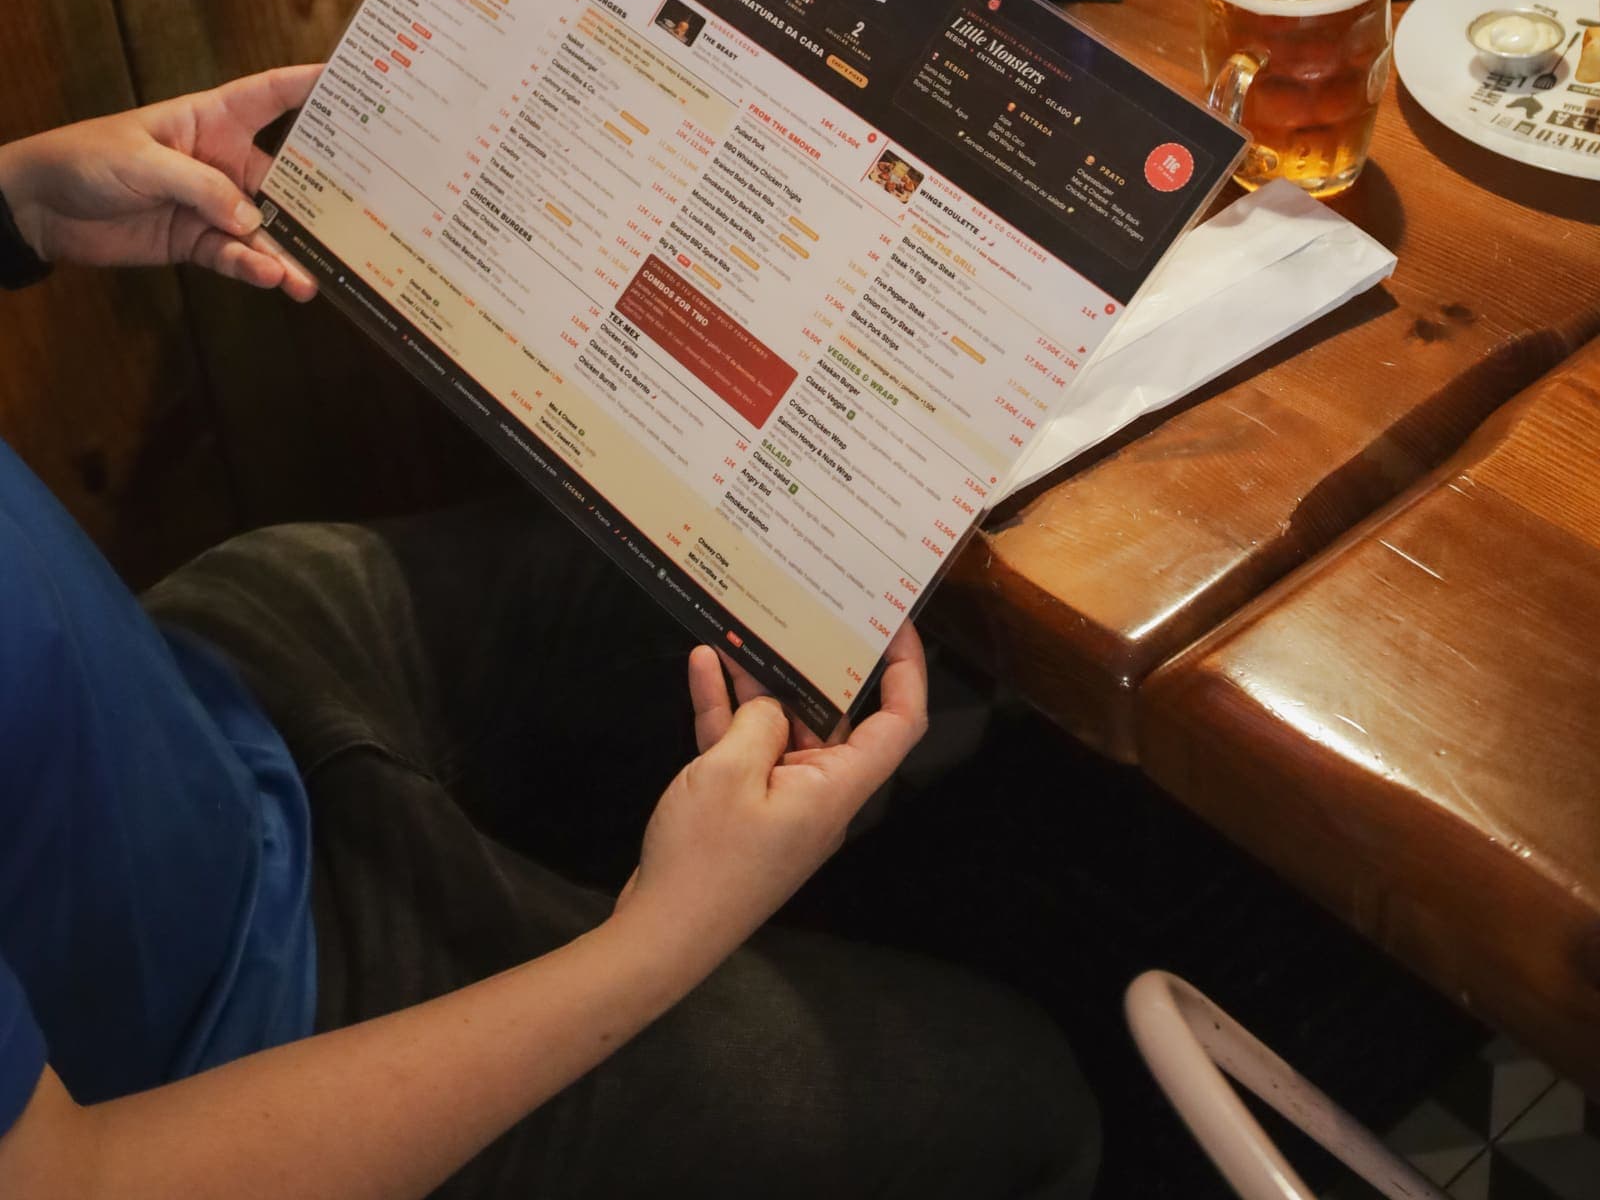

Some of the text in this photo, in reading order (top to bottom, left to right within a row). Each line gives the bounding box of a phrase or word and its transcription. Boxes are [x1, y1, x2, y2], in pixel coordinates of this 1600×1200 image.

[703, 32, 737, 59] THE BEAST
[784, 25, 797, 39] DA
[799, 35, 823, 57] CASA
[851, 21, 864, 37] 2
[561, 42, 597, 72] Cheeseburger
[950, 16, 1045, 84] Little Monsters
[944, 60, 968, 79] BEBIDA
[944, 30, 1071, 118] BEBIDA ENTRADA PRATO GELADO
[734, 124, 765, 151] Pulled Pork
[748, 103, 820, 159] FROM THE SMOKER
[1019, 111, 1052, 136] ENTRADA
[983, 150, 996, 160] com
[998, 137, 1014, 151] Wings
[1017, 150, 1036, 166] Nachos
[303, 173, 323, 192] SIDES
[723, 140, 801, 203] BBQ Whiskey Chicken Thighs
[1076, 168, 1114, 195] Cheeseburger
[1099, 165, 1124, 185] PRATO
[470, 187, 532, 241] CHICKEN BURGERS
[919, 188, 979, 234] WINGS ROULETTE
[1065, 183, 1143, 241] Chicken Tenders Fish Fingers
[1071, 175, 1082, 187] Mac
[1087, 187, 1108, 204] Cheese
[1111, 203, 1125, 216] Baby
[1125, 213, 1139, 225] Back
[928, 175, 961, 201] NOVIDADE
[971, 206, 986, 219] RIBS
[994, 222, 1004, 232] CO
[1005, 231, 1047, 262] CHALLENGE
[901, 236, 955, 279] Blue Cheese Steak
[911, 223, 975, 276] FROM THE GRILL
[890, 253, 907, 269] Steak
[913, 270, 926, 284] Egg
[642, 269, 708, 326] COMBOS FOR TWO
[862, 293, 914, 336] Onion Gravy Steak
[874, 276, 925, 318] Five Pepper Steak
[1081, 306, 1096, 319] 11€
[600, 323, 638, 358] Chicken Fajitas
[609, 311, 639, 340] TEX-MEX
[850, 309, 899, 350] Black Pork Strips
[589, 339, 608, 358] Classic
[607, 354, 620, 368] Ribs
[623, 368, 632, 378] Co
[631, 375, 650, 394] Burrito
[817, 359, 860, 395] Alaskan Burger
[827, 345, 861, 375] VEGGIES
[869, 379, 898, 405] WRAPS
[805, 375, 846, 411] Classic Veggie
[789, 398, 846, 449] Crispy Chicken Wrap
[761, 438, 791, 467] SALADS
[777, 415, 798, 436] Salmon
[798, 432, 817, 452] Honey
[821, 452, 836, 467] Nuts
[836, 464, 852, 481] Wrap
[741, 468, 771, 496] Angry Bird
[752, 451, 790, 485] Classic Salad
[724, 491, 768, 532] Smoked Salmon
[715, 552, 728, 567] Chips
